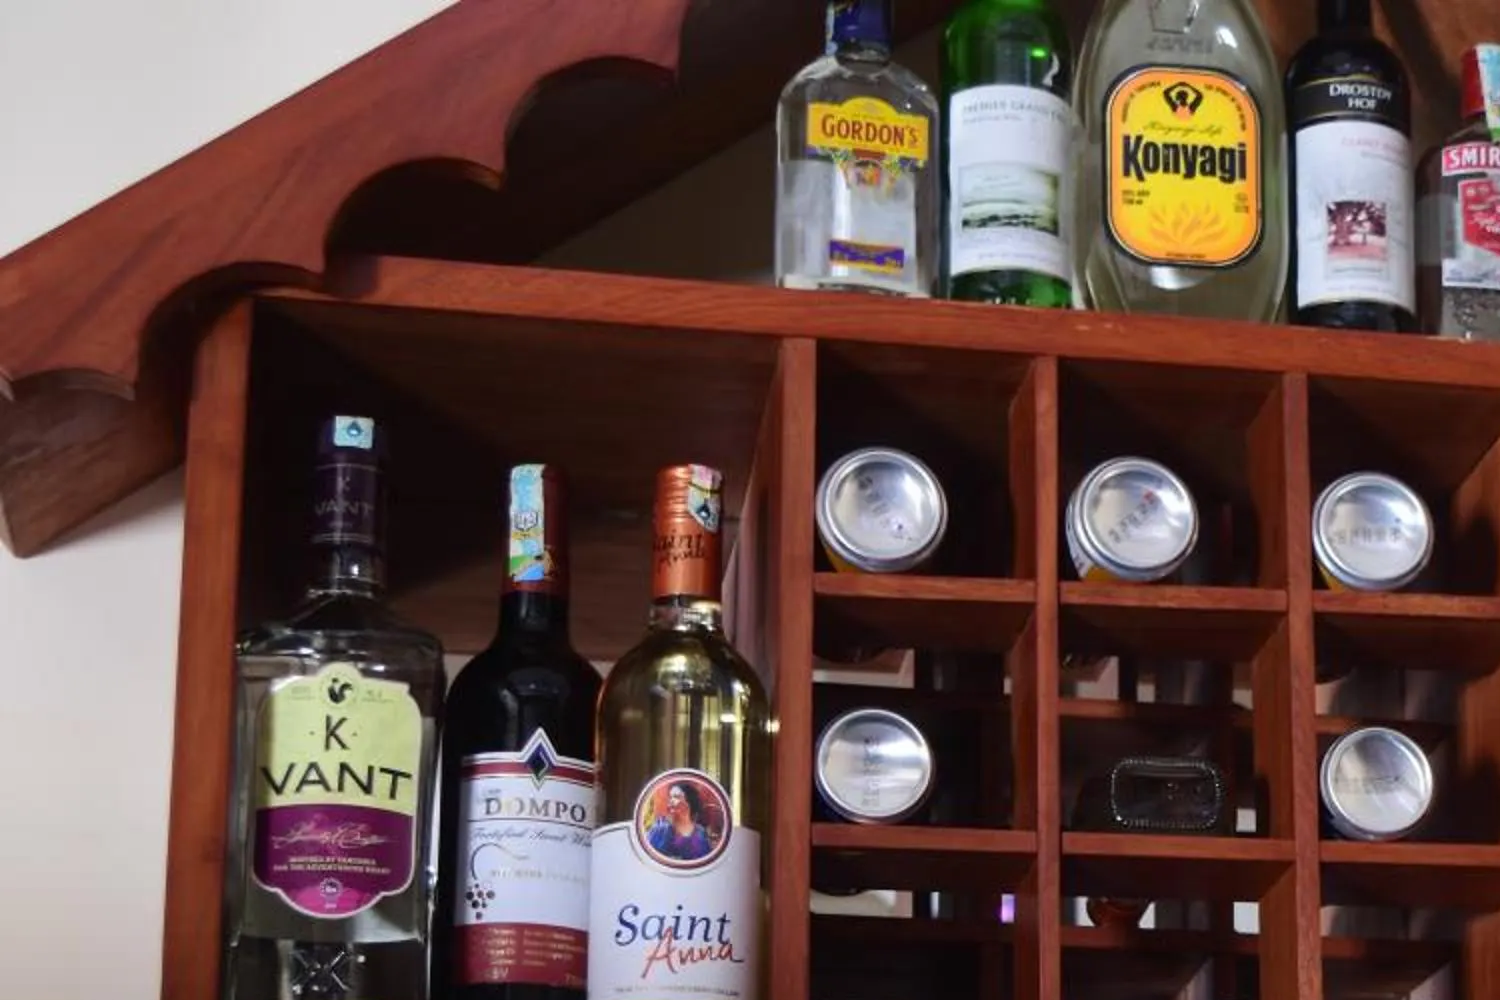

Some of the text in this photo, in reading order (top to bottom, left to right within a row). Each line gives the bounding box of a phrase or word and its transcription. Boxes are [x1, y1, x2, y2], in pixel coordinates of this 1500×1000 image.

[1347, 97, 1377, 110] HOF
[821, 113, 921, 147] GORDON'S
[1121, 134, 1248, 184] Konyagi
[323, 714, 351, 752] K
[261, 761, 412, 799] VANT
[614, 904, 732, 947] Saint
[641, 926, 746, 979] Anna
